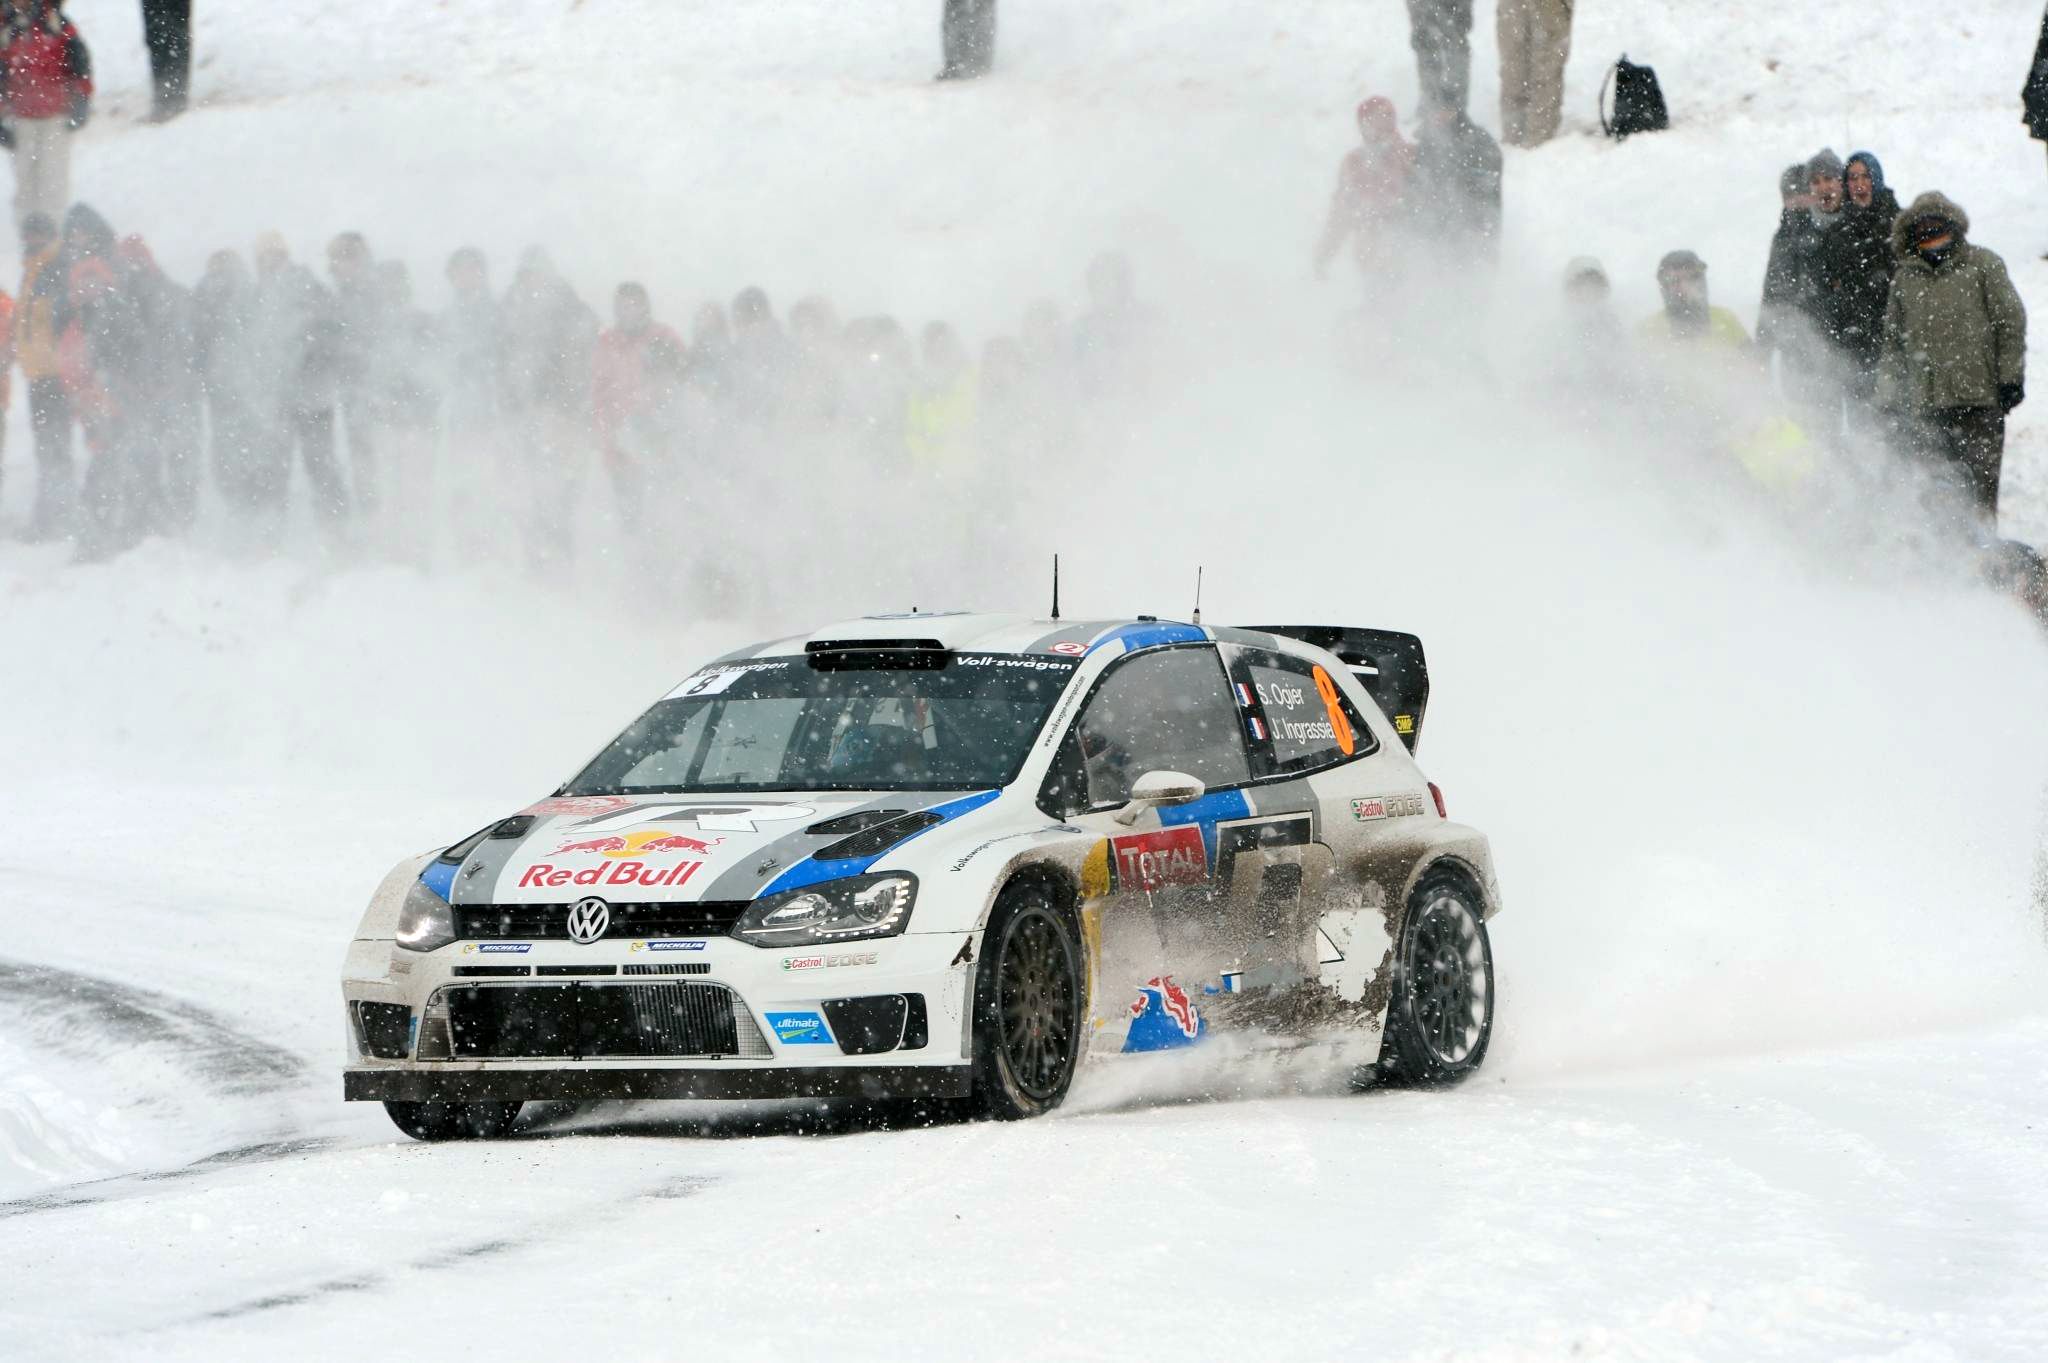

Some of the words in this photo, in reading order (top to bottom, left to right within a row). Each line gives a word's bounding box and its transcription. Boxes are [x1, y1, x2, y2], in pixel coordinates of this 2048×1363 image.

[957, 657, 1073, 670] Volkswagen
[686, 675, 720, 695] 8
[1256, 684, 1272, 705] S.
[1272, 682, 1305, 710] Ogier
[1312, 664, 1354, 756] 8
[1271, 721, 1284, 741] J.
[1284, 718, 1336, 745] Ingrassia
[1360, 801, 1385, 817] Castrol
[1120, 846, 1203, 880] TOTAL
[518, 861, 610, 888] Red
[606, 861, 703, 887] Bull
[652, 942, 706, 950] MICHELIN
[792, 958, 822, 969] Castrol
[826, 952, 879, 968] EDGE
[777, 1018, 820, 1028] ultimate
